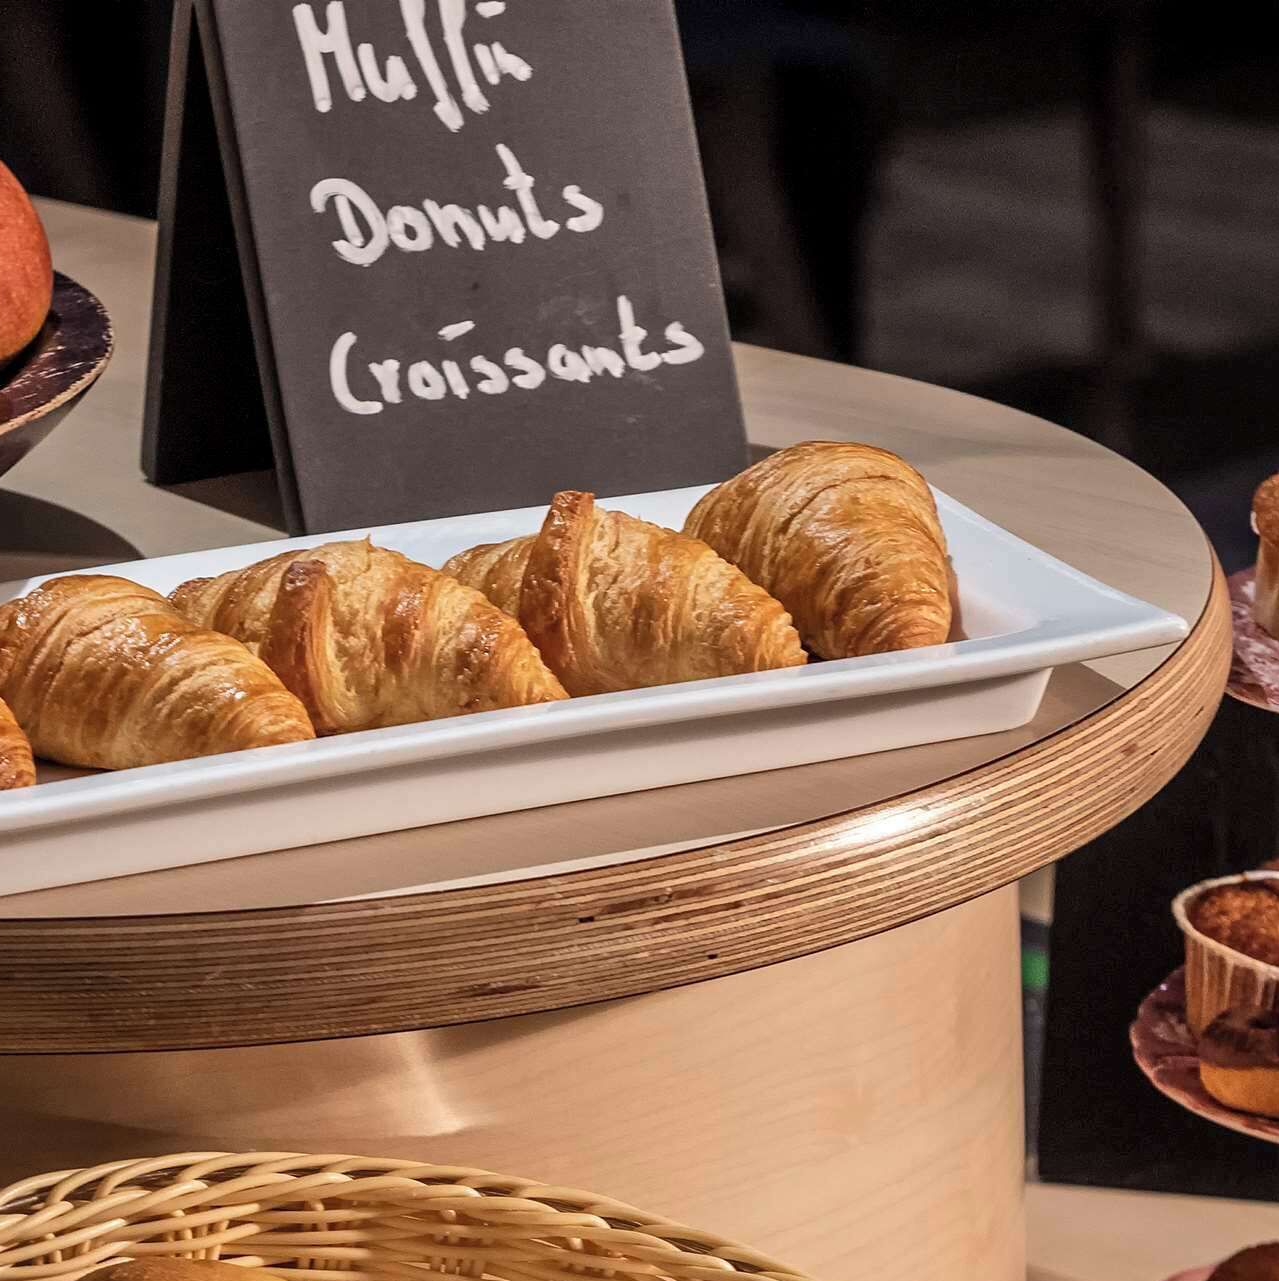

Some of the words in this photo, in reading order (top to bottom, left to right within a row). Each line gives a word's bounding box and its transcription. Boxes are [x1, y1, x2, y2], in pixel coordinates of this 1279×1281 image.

[291, 0, 533, 133] Muffin
[309, 143, 605, 268] Donuts
[328, 295, 706, 416] Croissants
